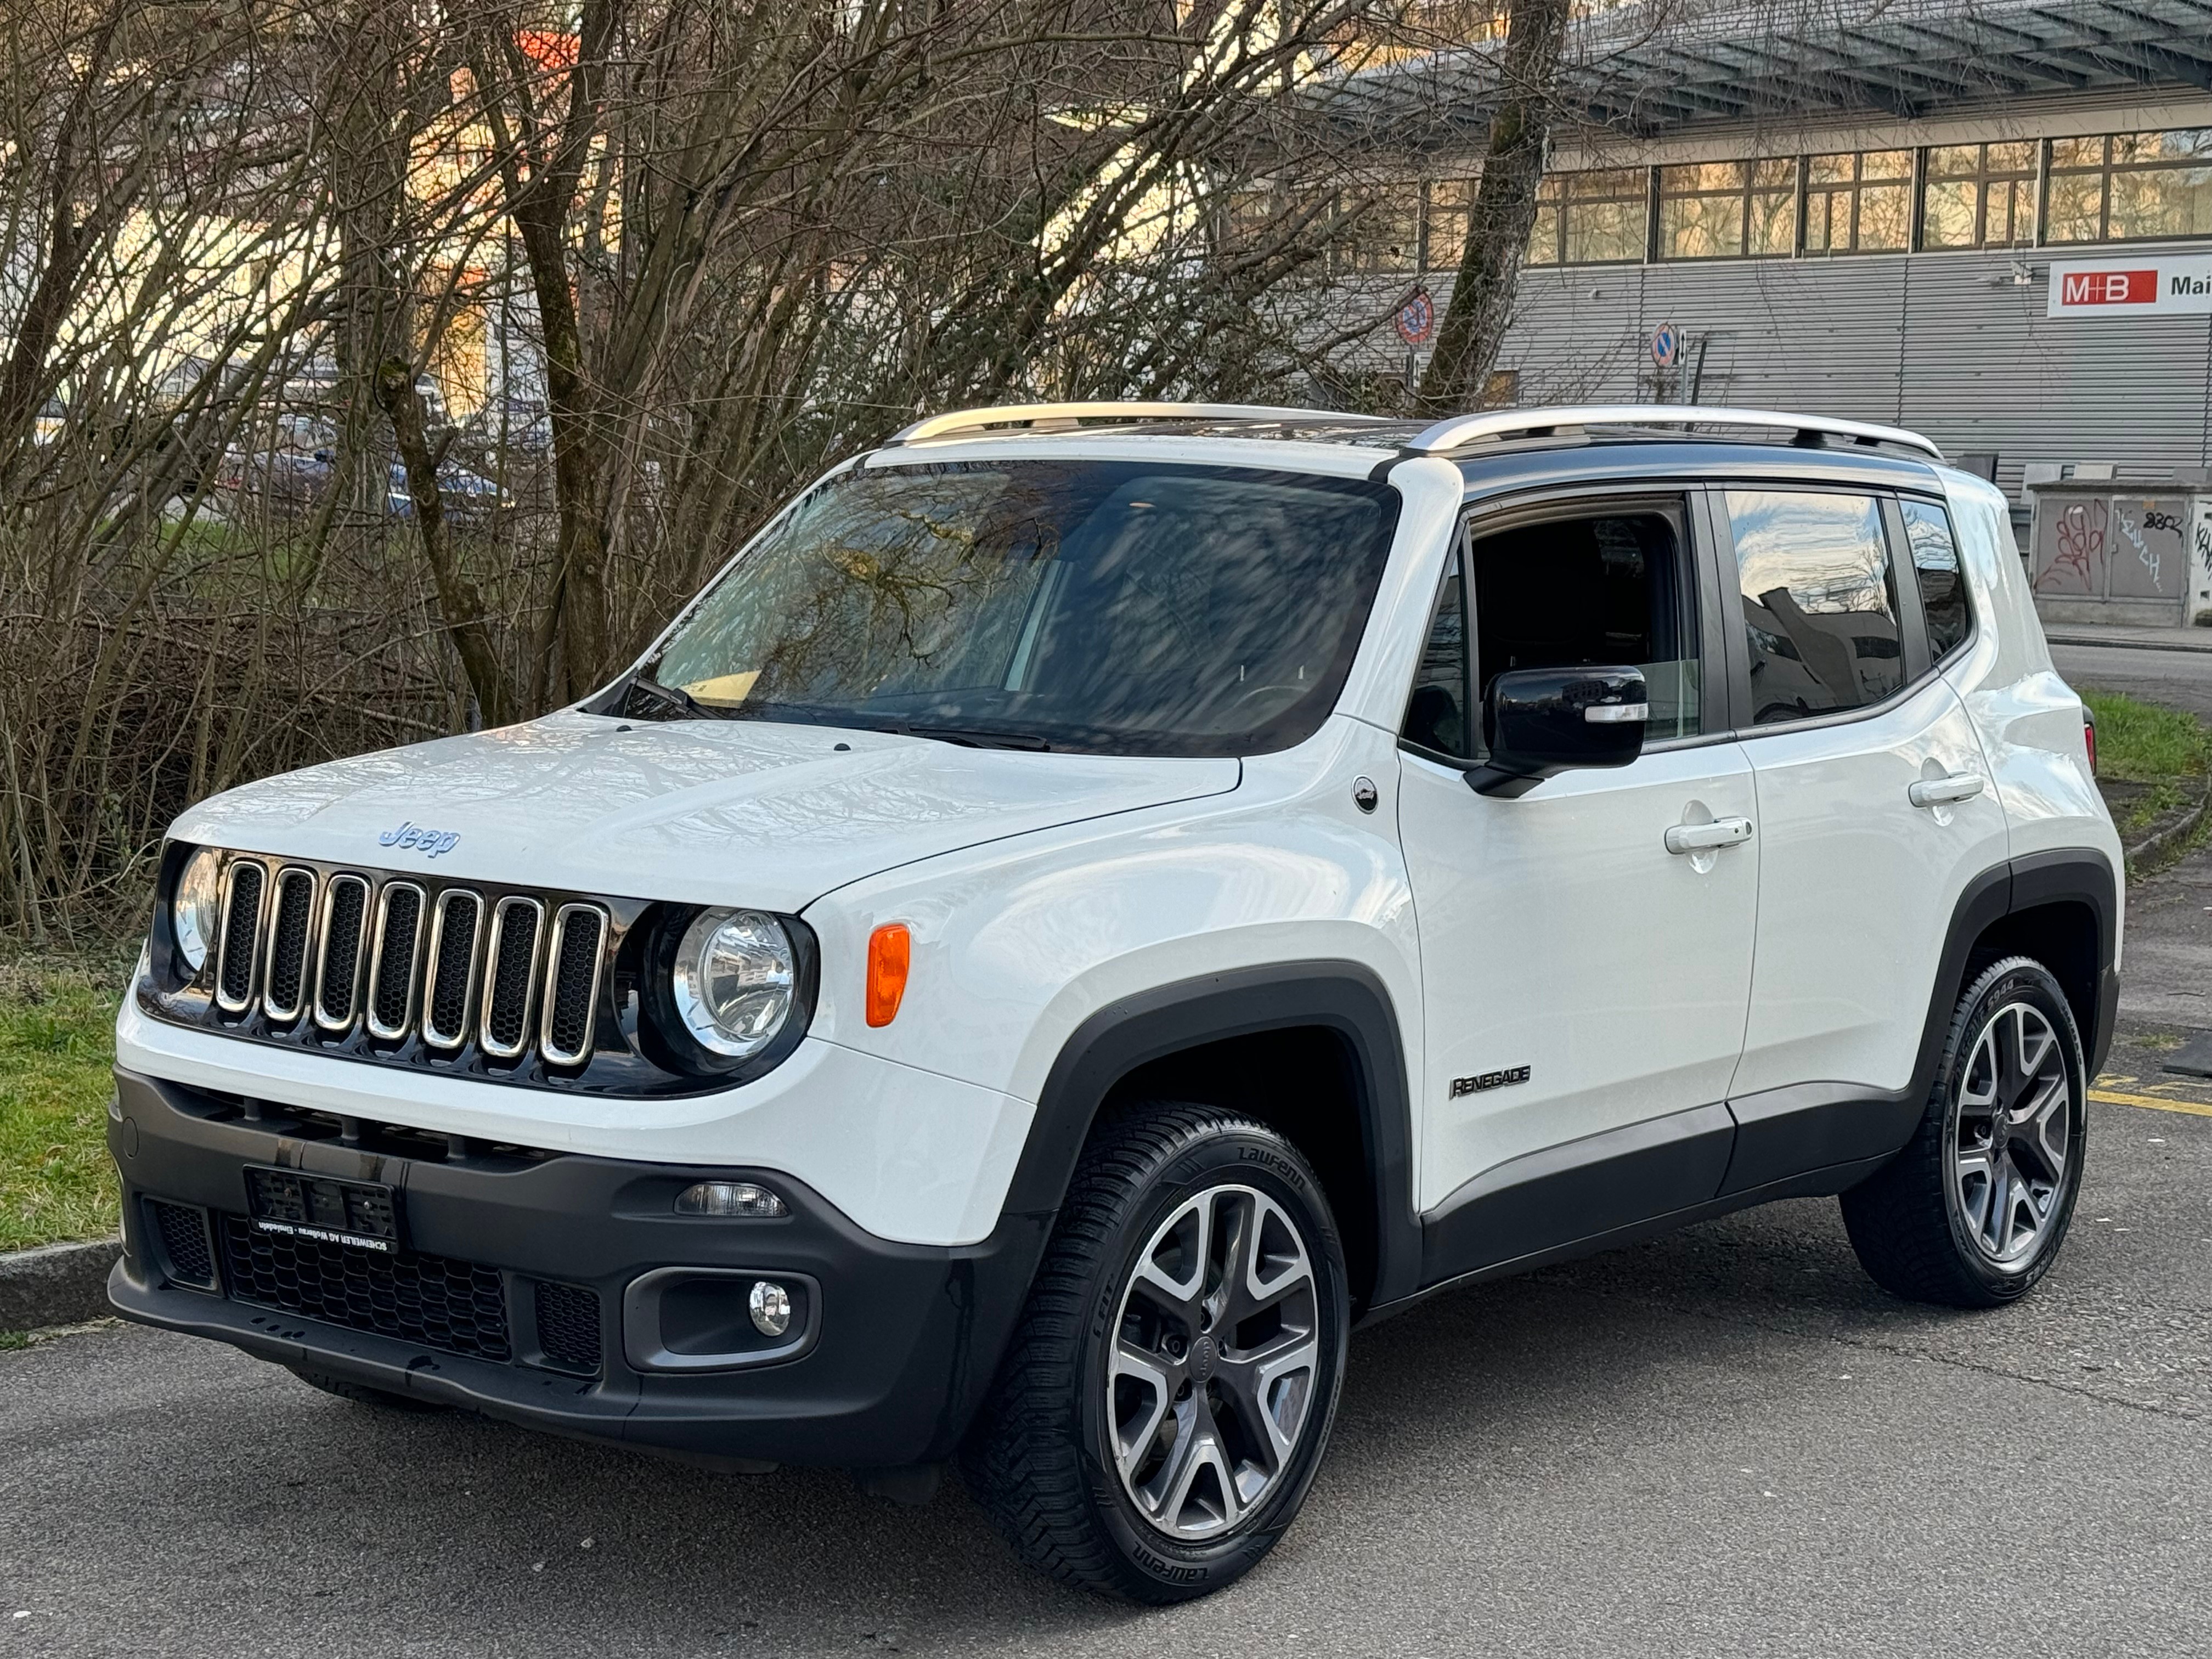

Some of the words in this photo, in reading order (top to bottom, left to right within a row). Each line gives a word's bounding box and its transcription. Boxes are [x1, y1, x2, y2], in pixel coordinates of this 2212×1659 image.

[2065, 275, 2130, 303] M+B
[2171, 275, 2211, 296] Mai
[379, 821, 461, 859] Jeep
[1449, 1064, 1531, 1101] RENEGADE
[329, 1233, 340, 1243] AG
